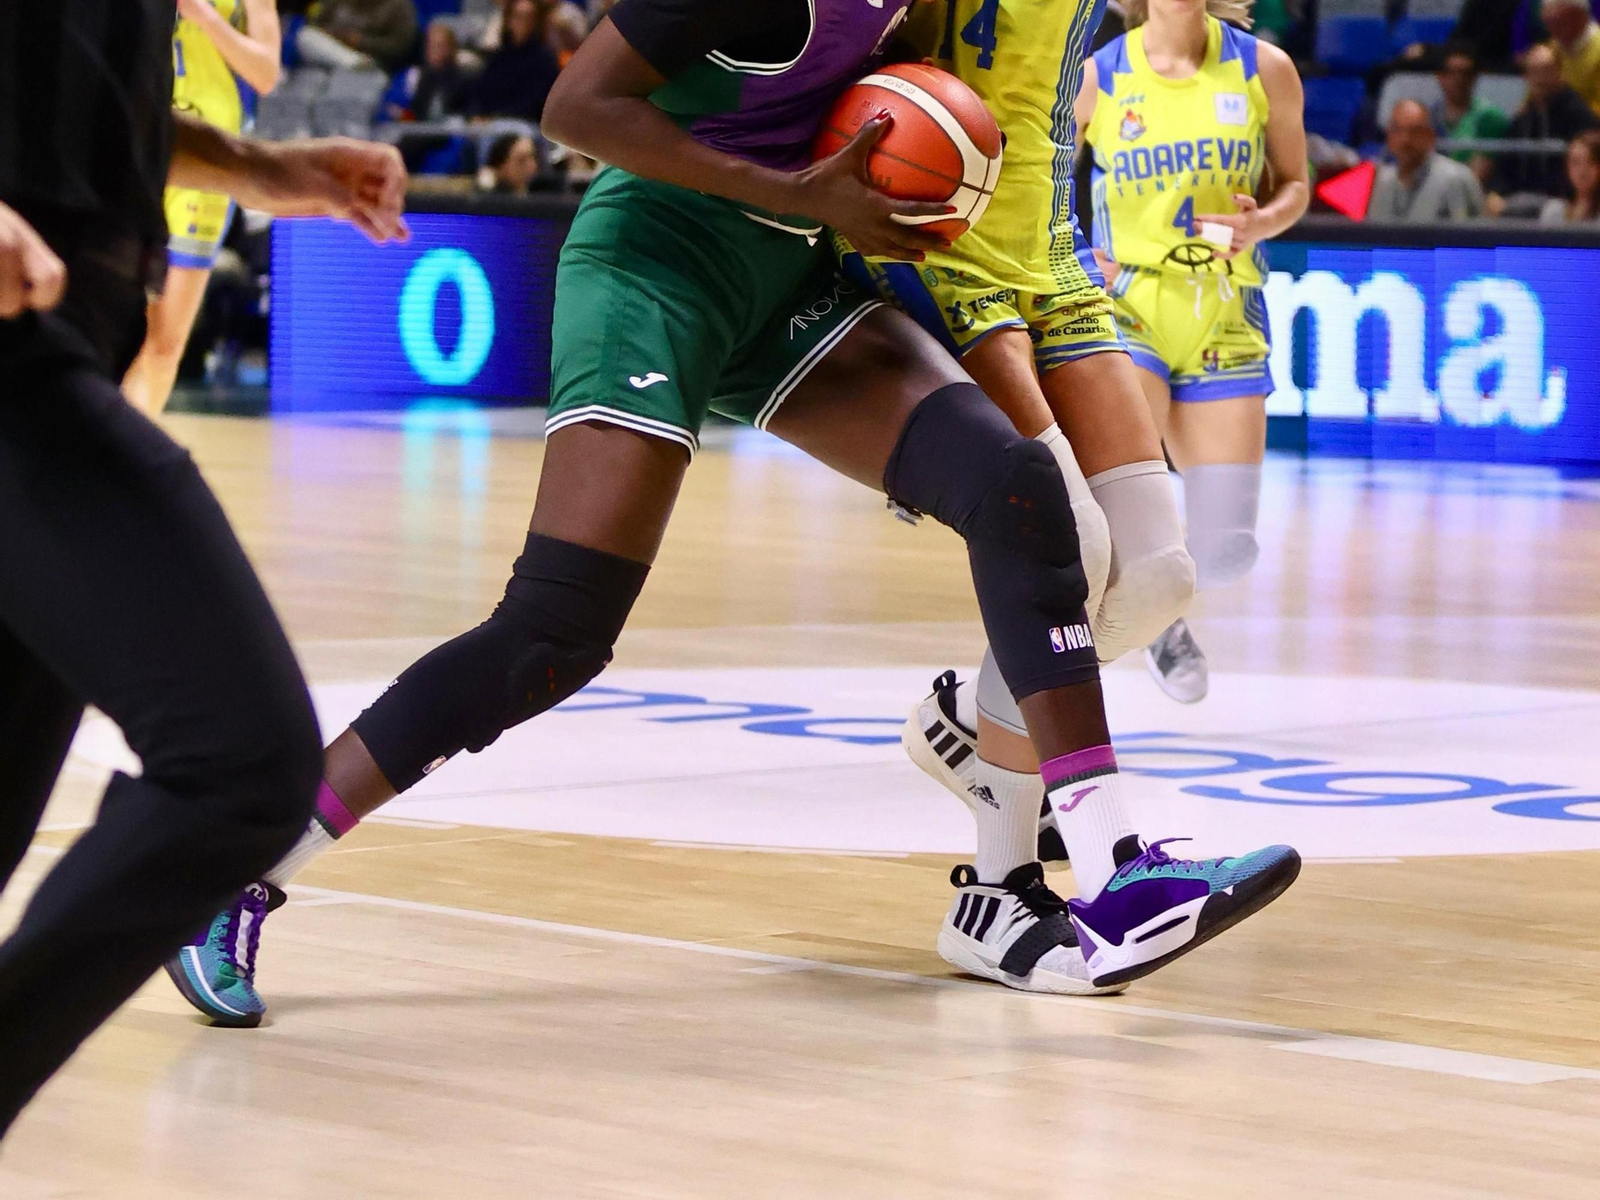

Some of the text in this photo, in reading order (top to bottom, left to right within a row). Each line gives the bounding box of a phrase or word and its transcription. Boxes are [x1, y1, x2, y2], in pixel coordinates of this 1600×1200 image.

[1113, 138, 1251, 183] ADAREVA
[1172, 196, 1195, 238] 4
[1048, 327, 1062, 337] de
[1063, 623, 1094, 650] NBA
